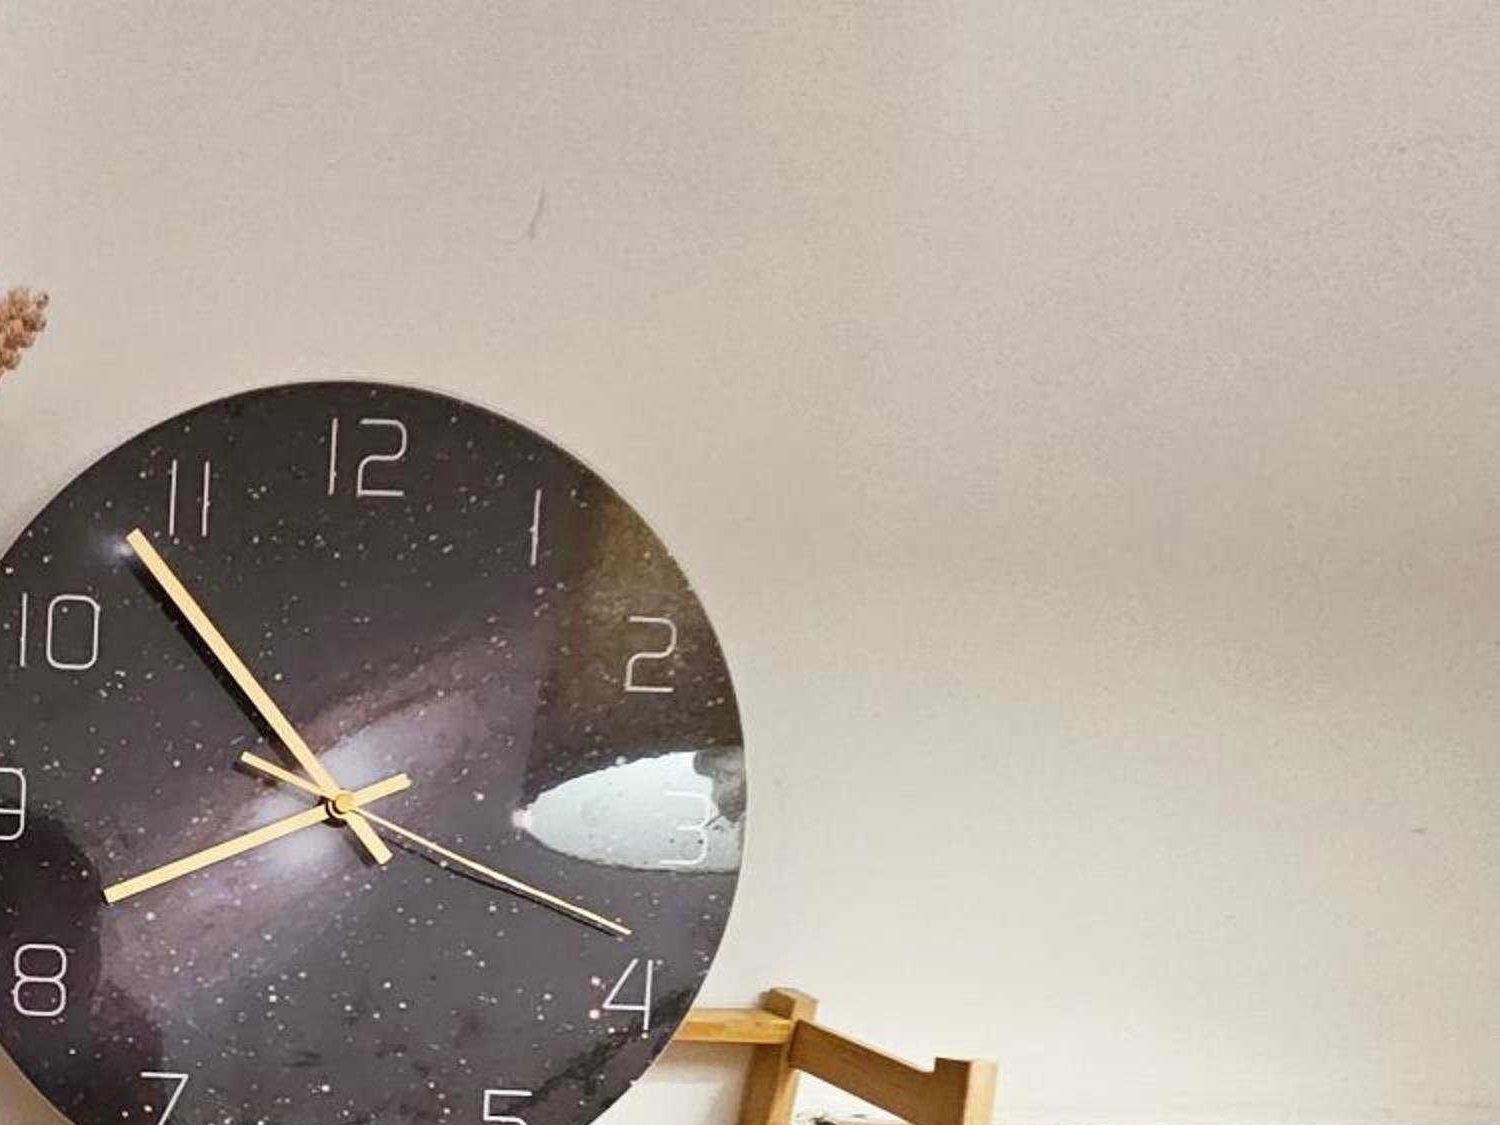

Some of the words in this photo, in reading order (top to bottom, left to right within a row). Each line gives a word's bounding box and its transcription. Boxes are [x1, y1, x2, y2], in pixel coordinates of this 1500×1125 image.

[328, 417, 407, 498] 12
[169, 459, 210, 537] 11
[530, 488, 541, 566] 1
[19, 592, 100, 670] 10
[624, 616, 678, 693] 2
[660, 790, 711, 867] 3
[12, 944, 68, 1017] 8
[602, 959, 654, 1031] 4
